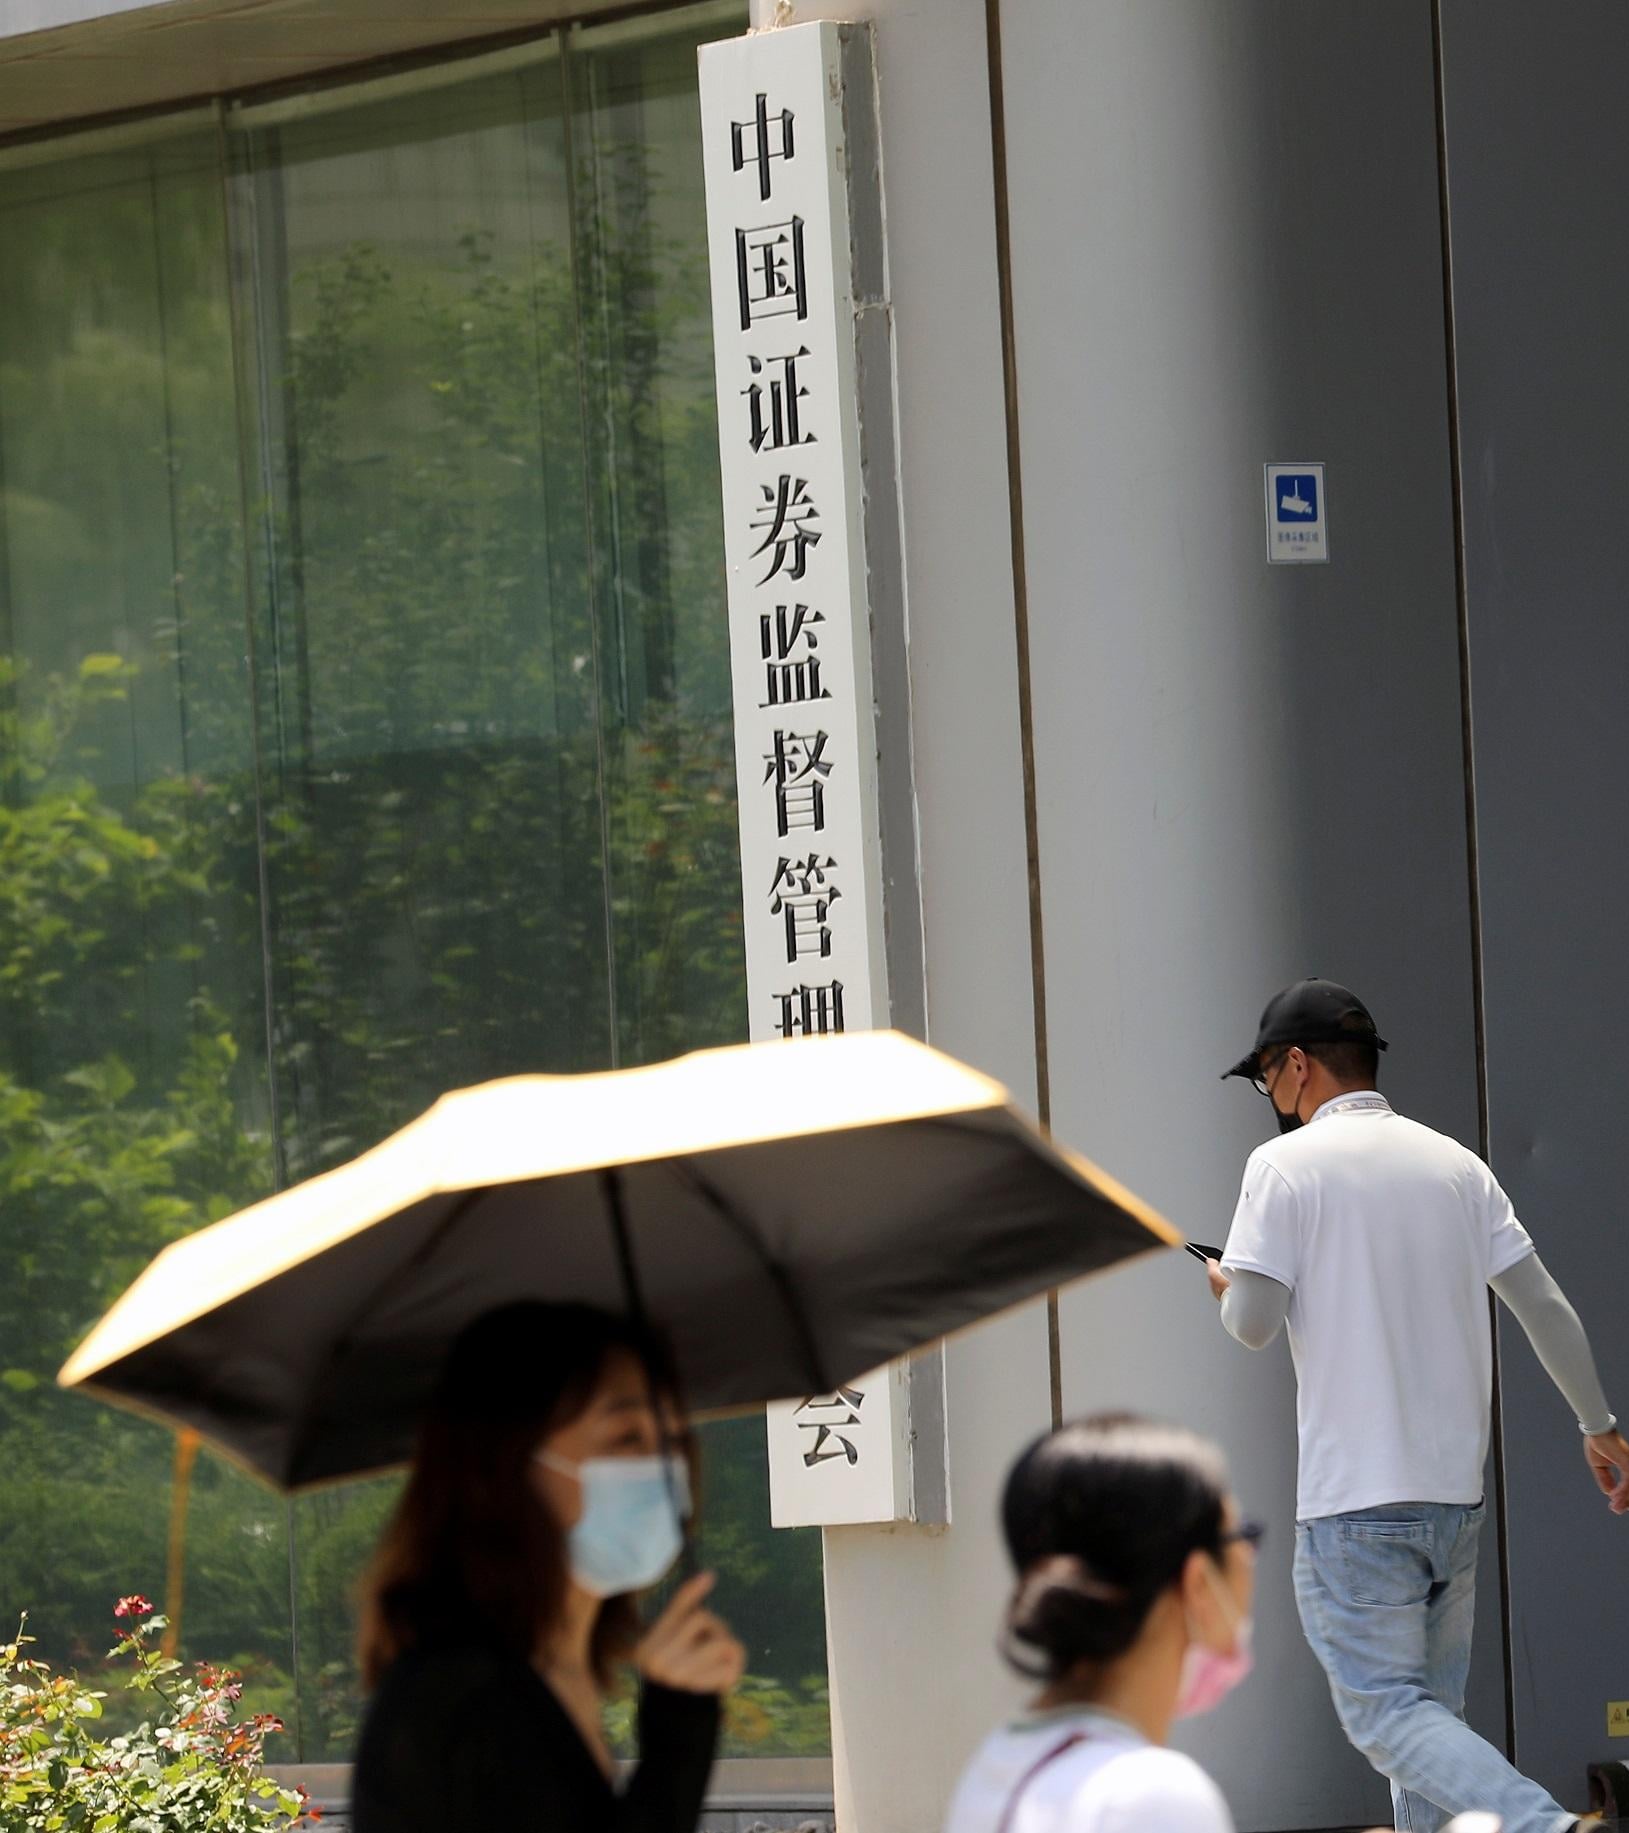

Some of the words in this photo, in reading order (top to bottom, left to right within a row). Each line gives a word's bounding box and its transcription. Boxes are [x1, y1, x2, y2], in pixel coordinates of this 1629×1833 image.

[730, 92, 865, 1468] 中国证券监督管理会
